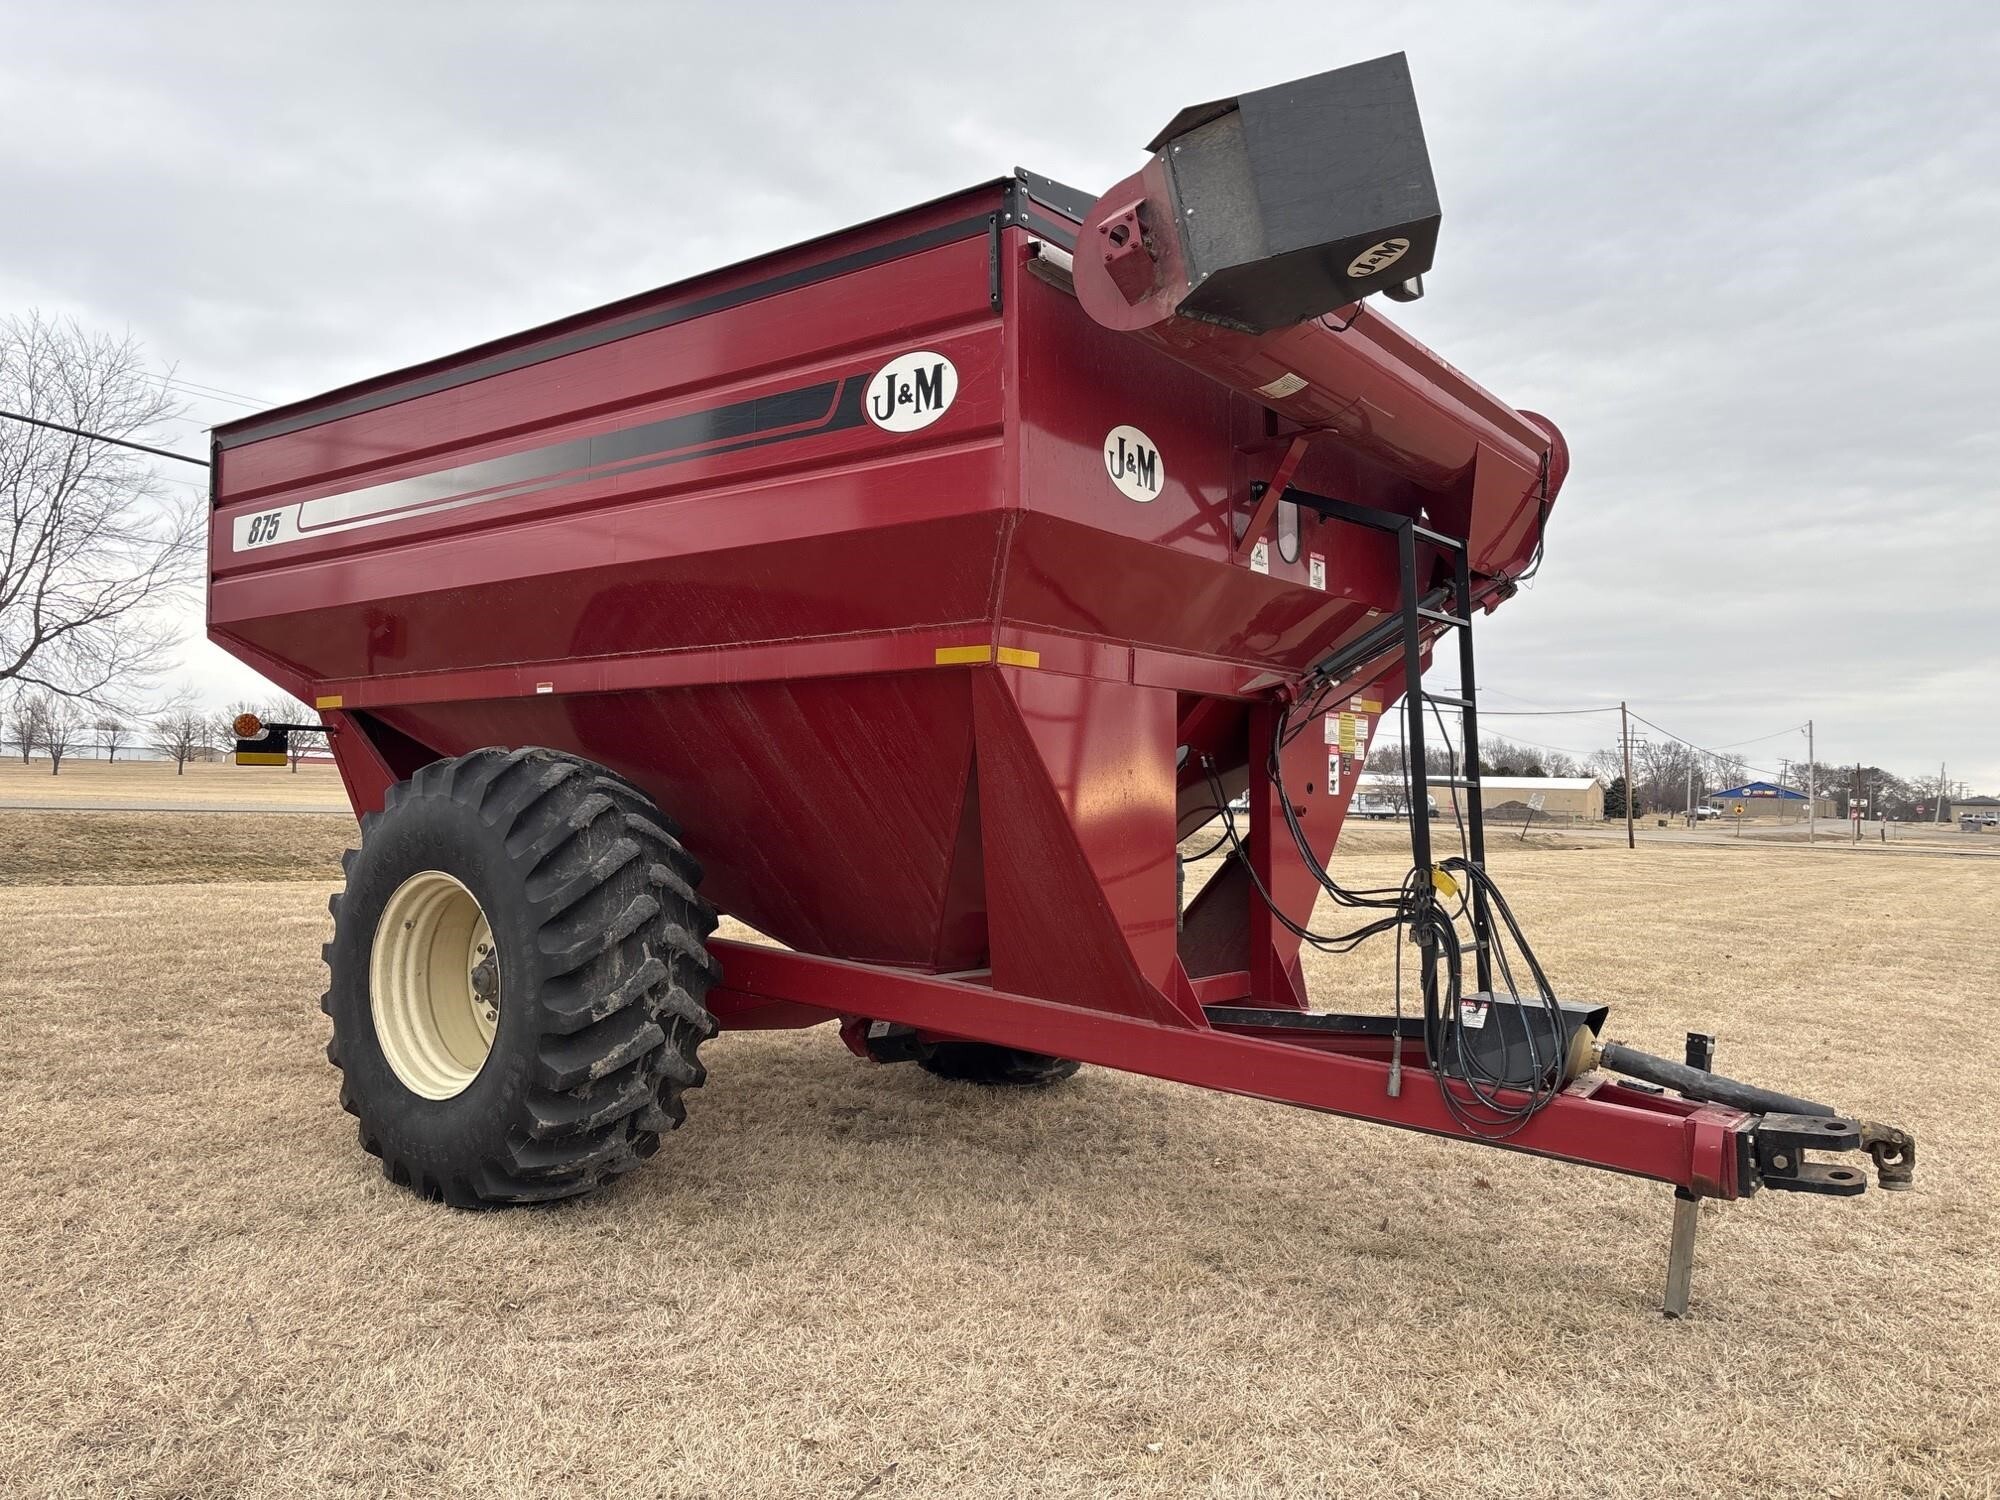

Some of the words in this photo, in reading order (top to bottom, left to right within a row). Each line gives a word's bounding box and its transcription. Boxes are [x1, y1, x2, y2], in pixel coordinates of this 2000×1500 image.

[1353, 241, 1408, 276] J&M
[872, 362, 945, 421] J&M
[1108, 436, 1157, 492] J&M
[248, 511, 282, 545] 875
